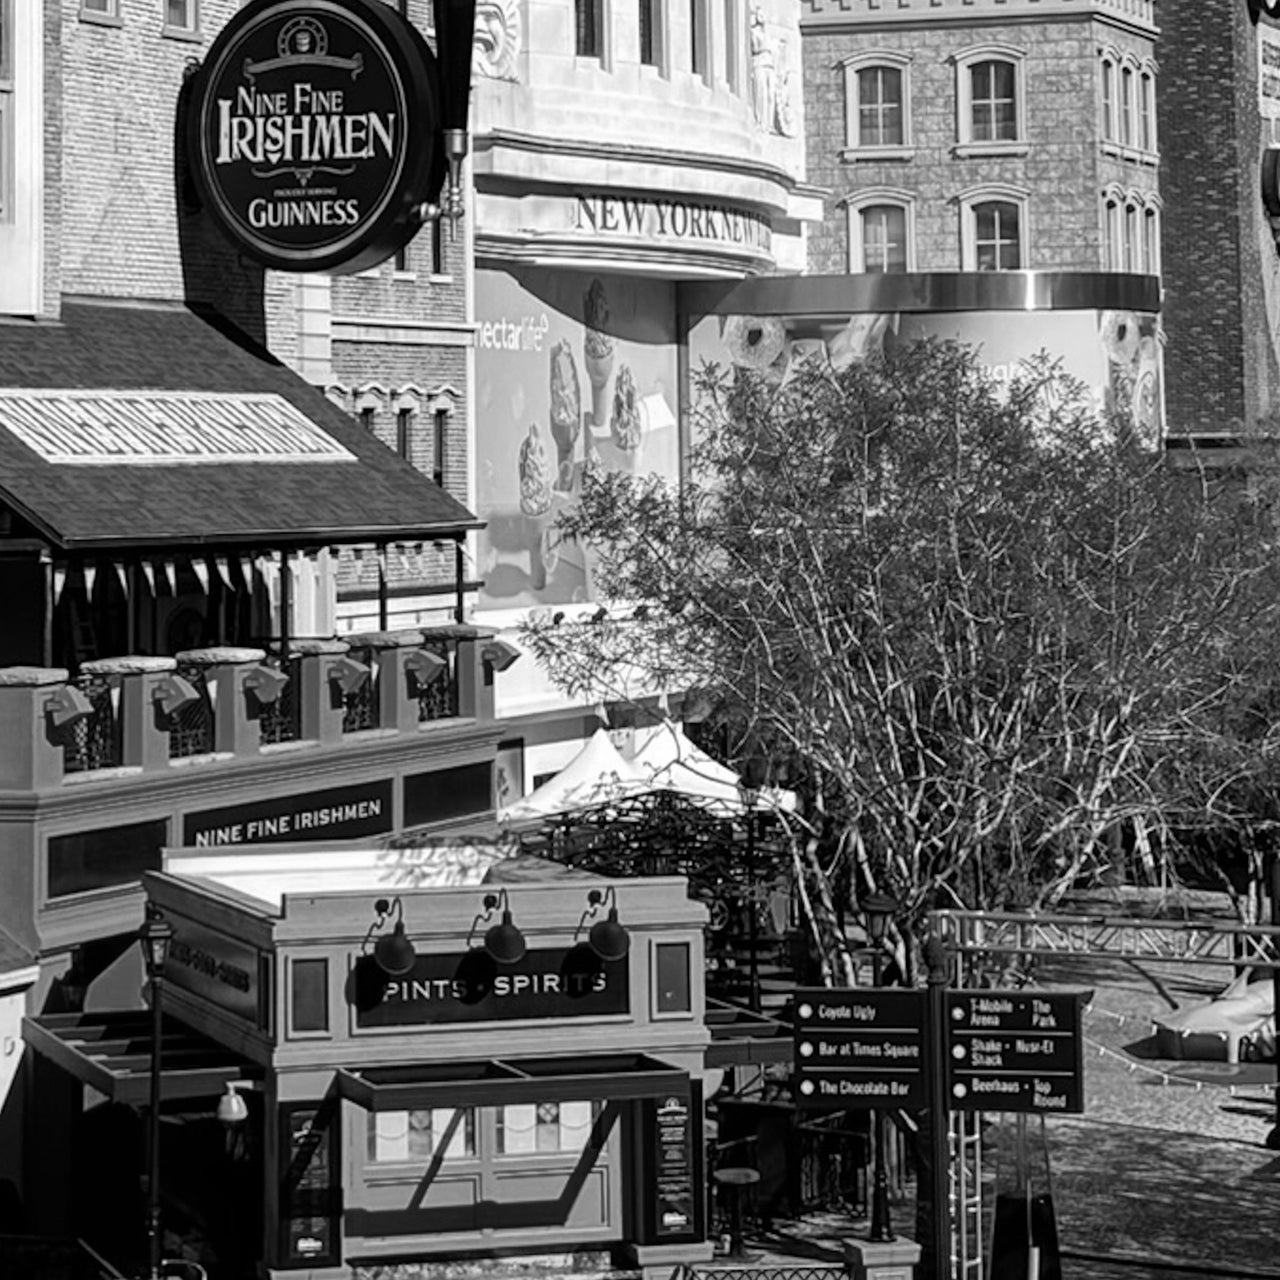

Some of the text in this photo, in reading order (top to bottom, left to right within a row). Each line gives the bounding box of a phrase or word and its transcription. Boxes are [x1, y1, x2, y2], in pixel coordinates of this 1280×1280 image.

[238, 82, 344, 117] NINE FINE
[216, 98, 396, 165] IRISHMEN
[248, 198, 360, 229] GUINNESS
[576, 194, 645, 233] NEW
[654, 202, 720, 240] YORK
[195, 799, 382, 847] NINE FINE IRISHMEN
[382, 972, 607, 1002] PINTS SPIRITS
[819, 1004, 876, 1021] Coyote Ugly
[970, 998, 1013, 1013] T-Mobile
[1032, 1000, 1051, 1014] The
[970, 1012, 1000, 1027] Arena
[1032, 1014, 1056, 1028] Park
[819, 1041, 919, 1058] Bar at Times Square
[971, 1038, 1002, 1054] Shake
[971, 1053, 1003, 1067] Shack
[819, 1079, 910, 1096] The Chocolate Bar
[972, 1077, 1020, 1094] Beerhaus
[1033, 1079, 1052, 1095] Top
[1033, 1094, 1066, 1108] Round
